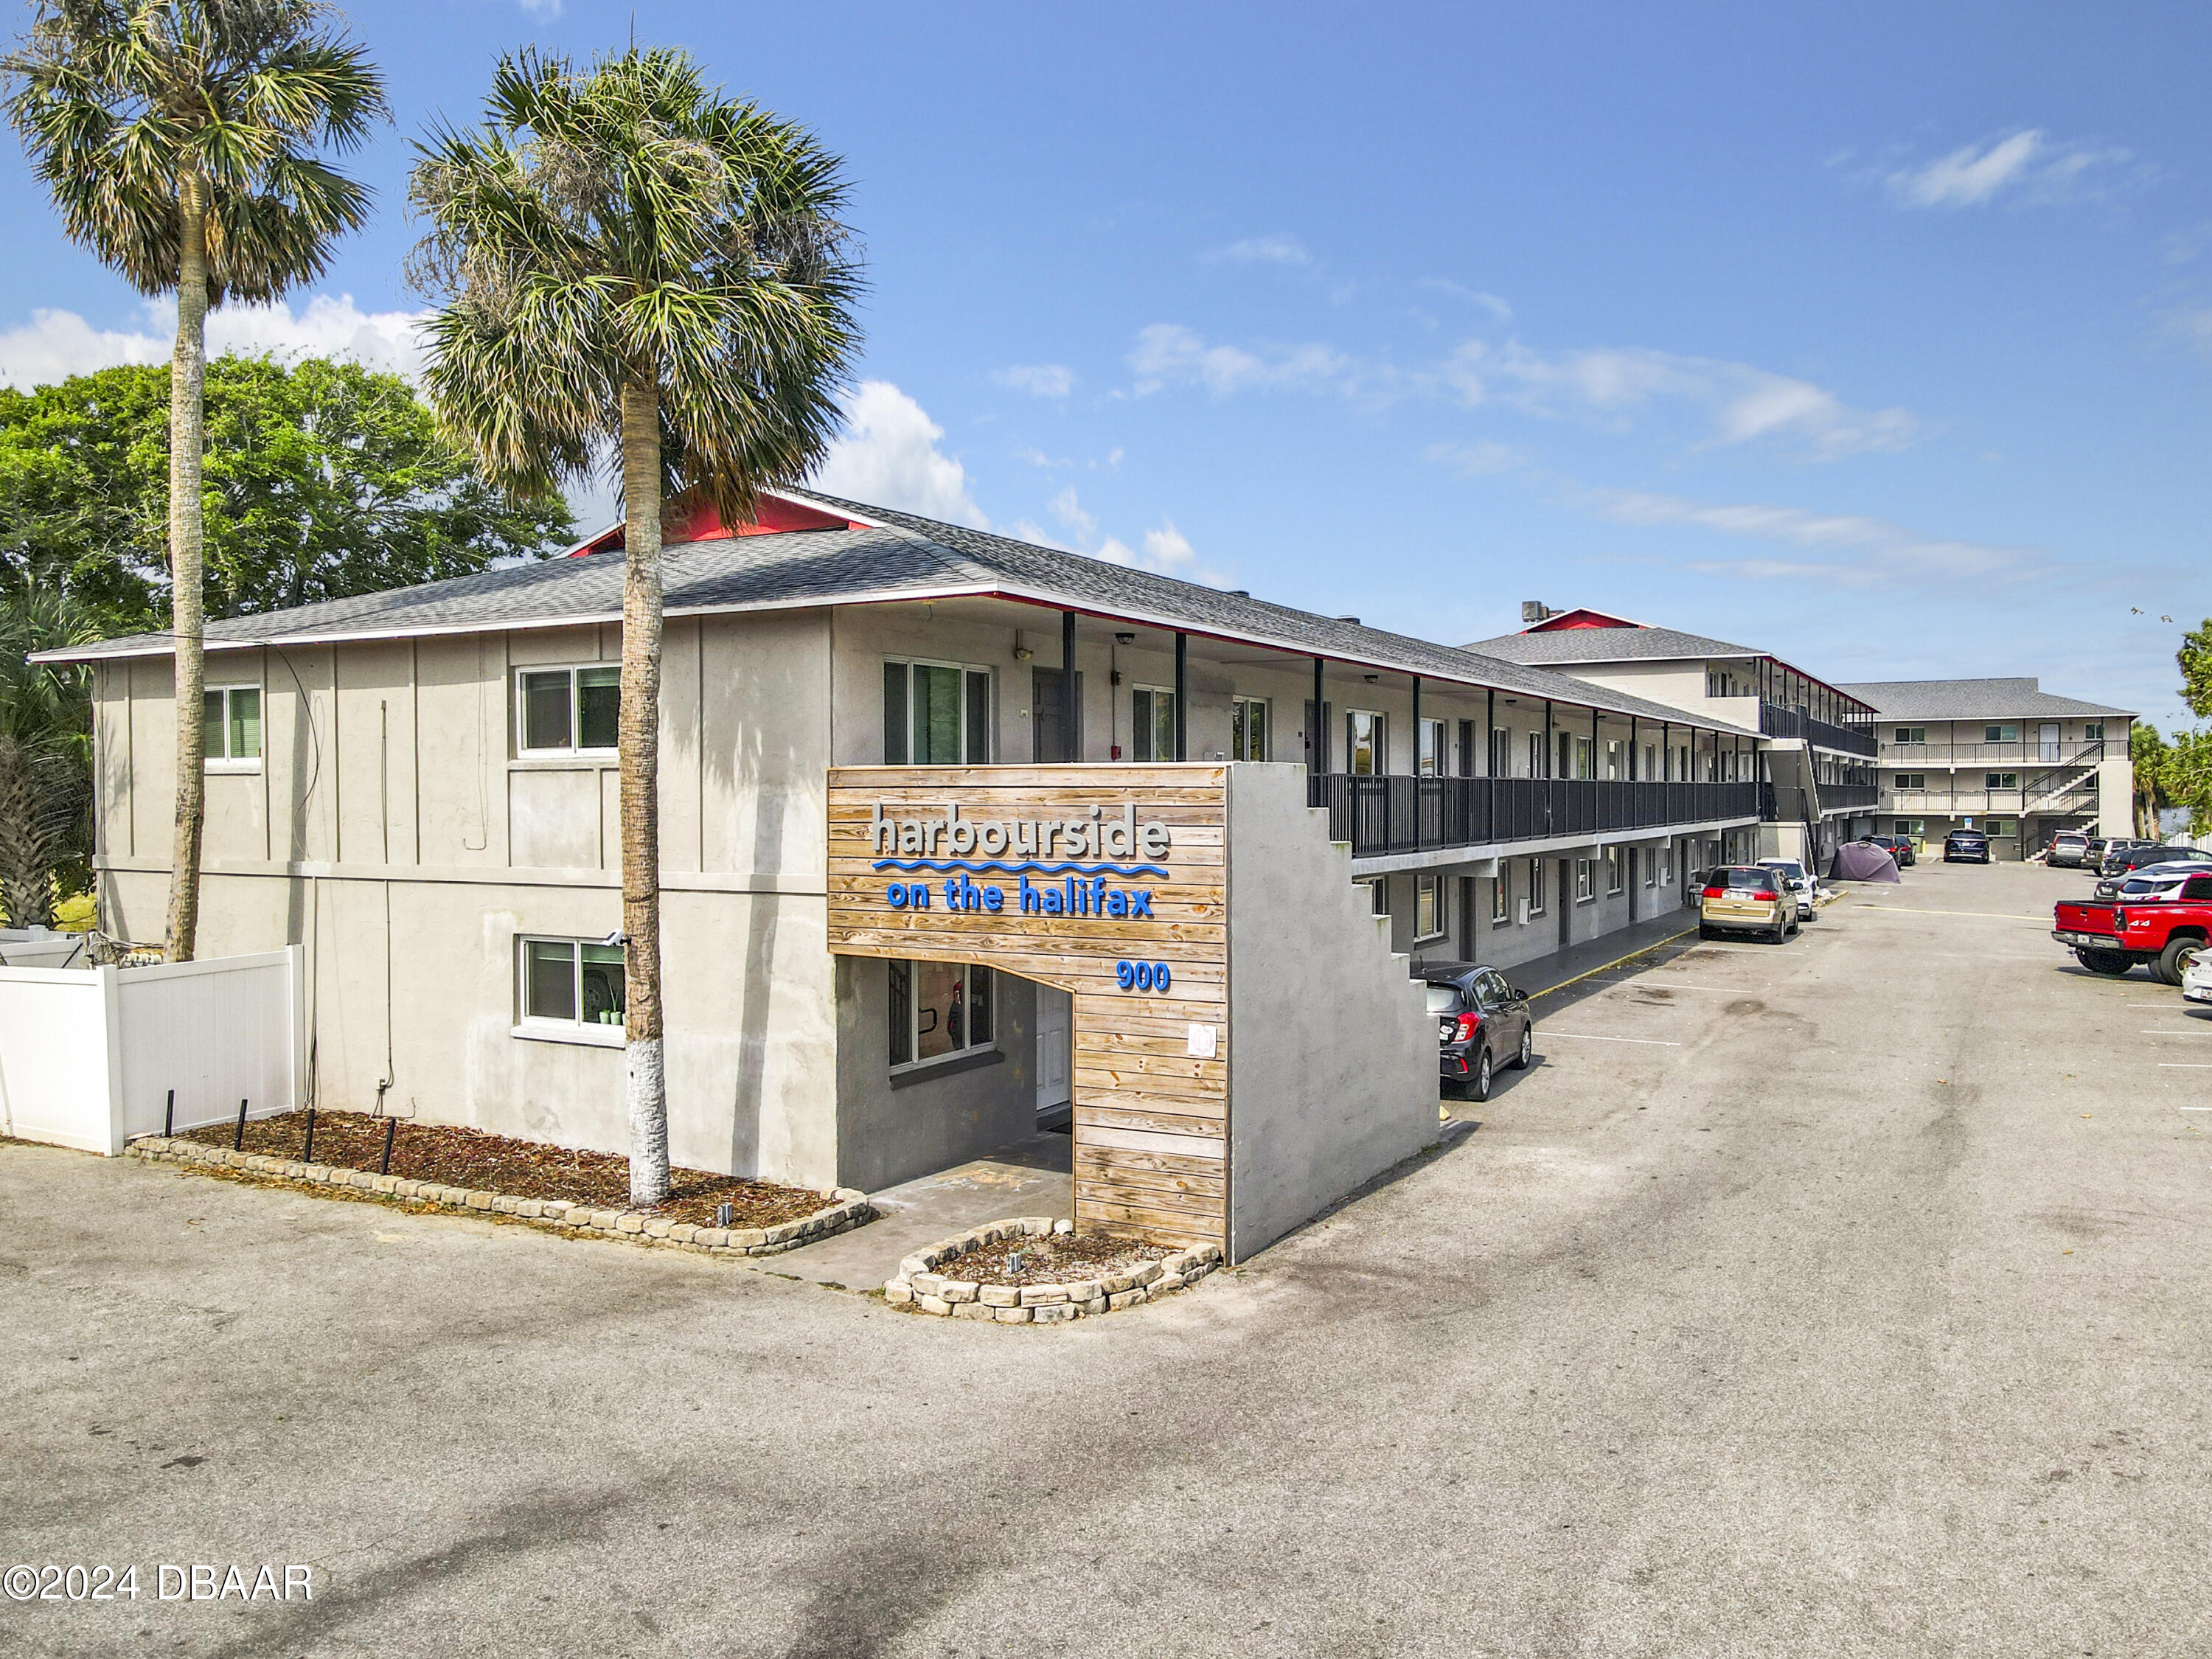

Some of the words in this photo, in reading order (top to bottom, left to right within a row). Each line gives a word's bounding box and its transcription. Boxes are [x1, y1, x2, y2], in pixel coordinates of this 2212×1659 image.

[872, 802, 1169, 857] harbourside
[887, 883, 929, 908] on
[944, 874, 1002, 910] the
[1020, 875, 1153, 916] halifax
[1116, 961, 1169, 990] 900
